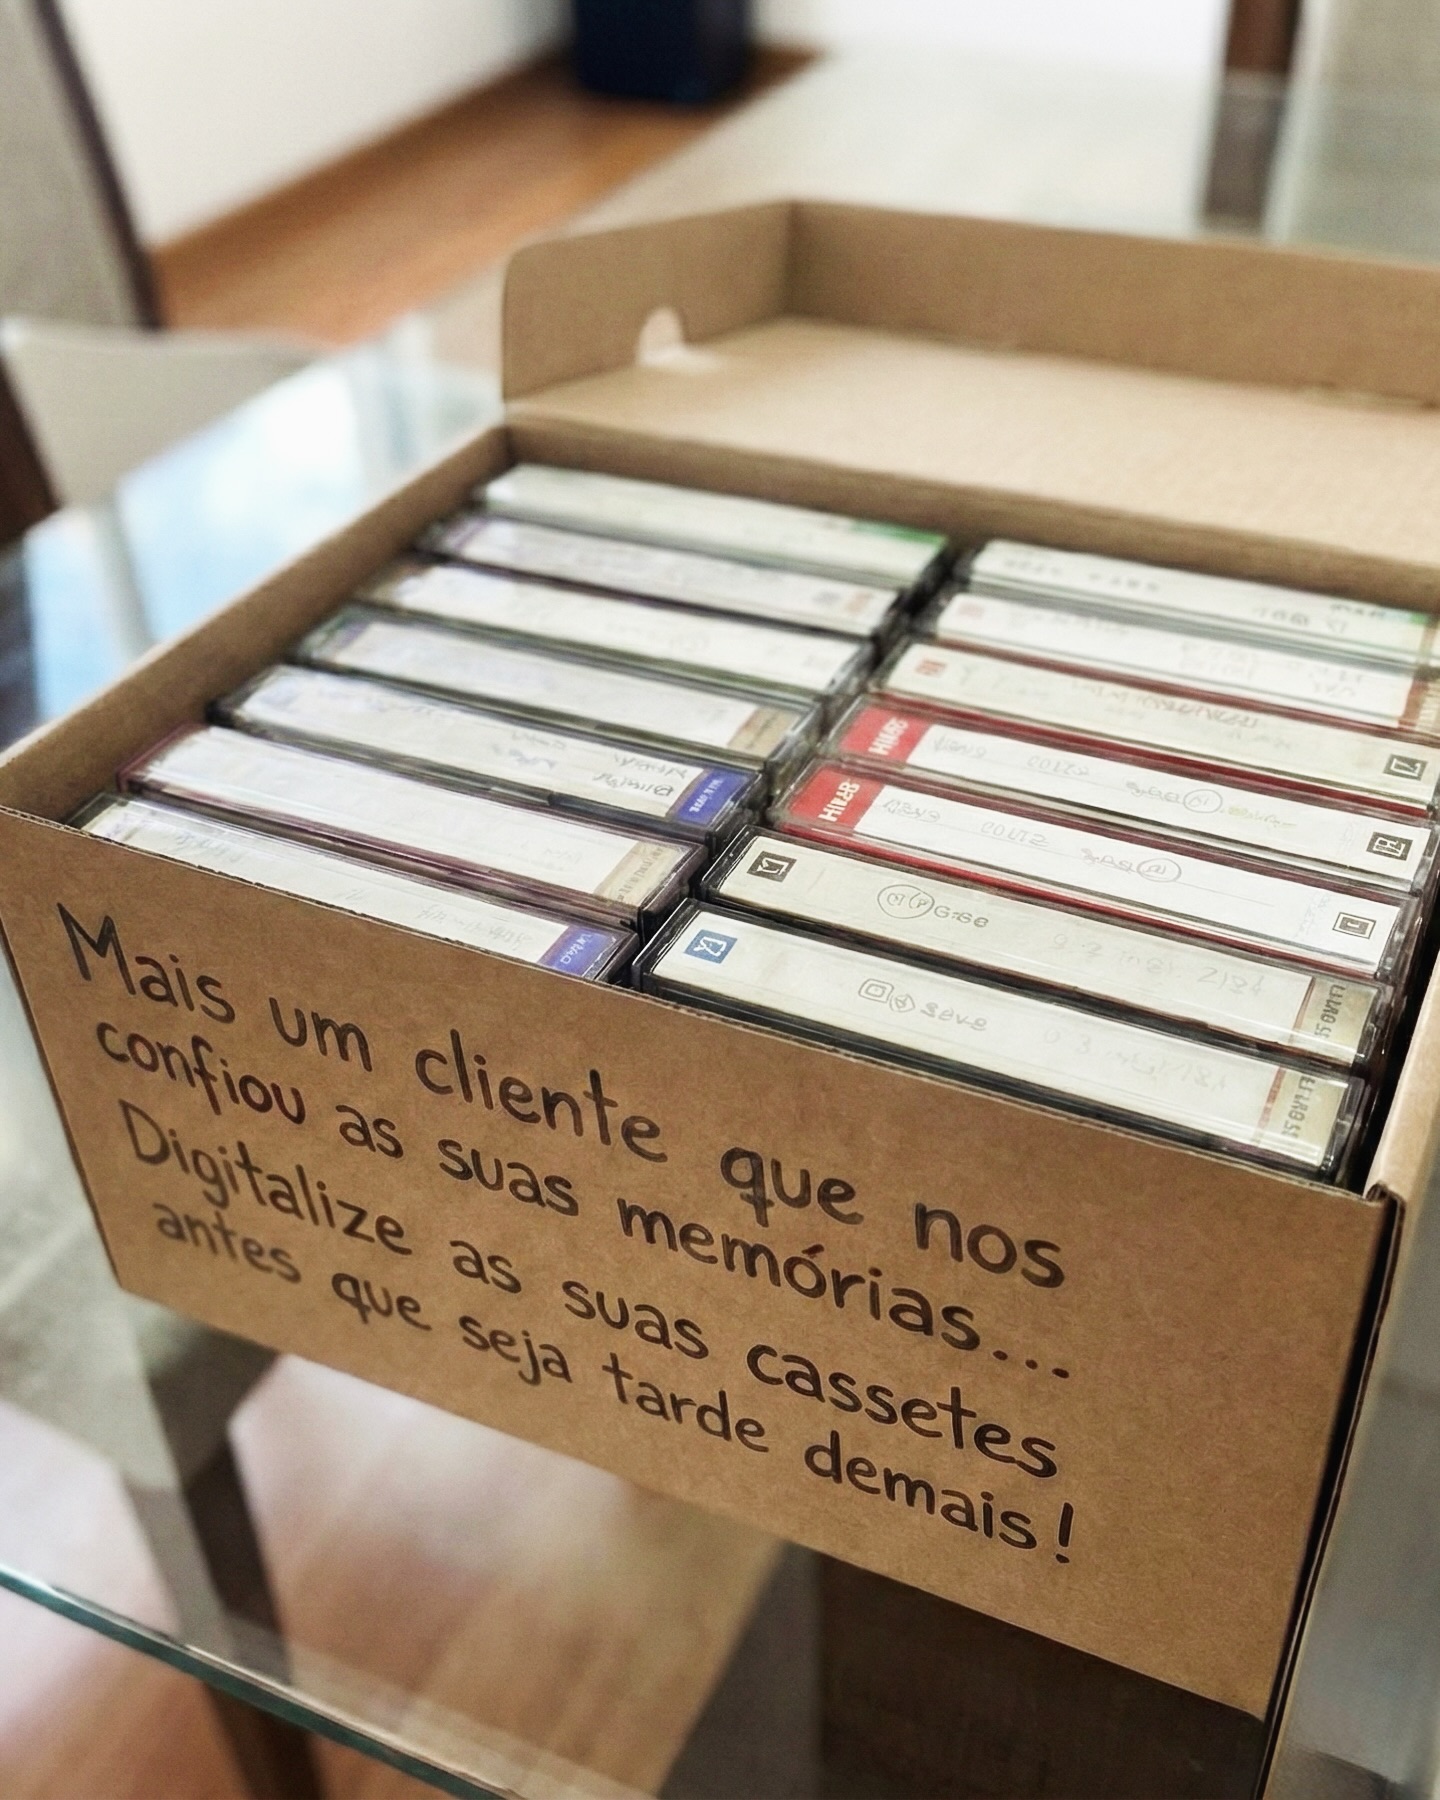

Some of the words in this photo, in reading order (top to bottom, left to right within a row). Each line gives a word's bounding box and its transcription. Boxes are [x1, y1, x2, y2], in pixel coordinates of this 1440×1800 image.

[57, 903, 236, 1024] Mais
[269, 998, 373, 1072] um
[414, 1029, 668, 1163] cliente
[720, 1146, 864, 1227] que
[914, 1202, 1066, 1289] nos
[96, 1022, 306, 1126] confiou
[335, 1104, 404, 1159] as
[437, 1138, 579, 1217] suas
[119, 1099, 413, 1256] Digitalize
[449, 1240, 523, 1295] as
[561, 1280, 710, 1360] suas
[746, 1343, 1058, 1479] cassetes
[152, 1202, 302, 1284] antes
[331, 1272, 433, 1332] que
[458, 1314, 574, 1387] seja
[602, 1352, 770, 1453] tarde
